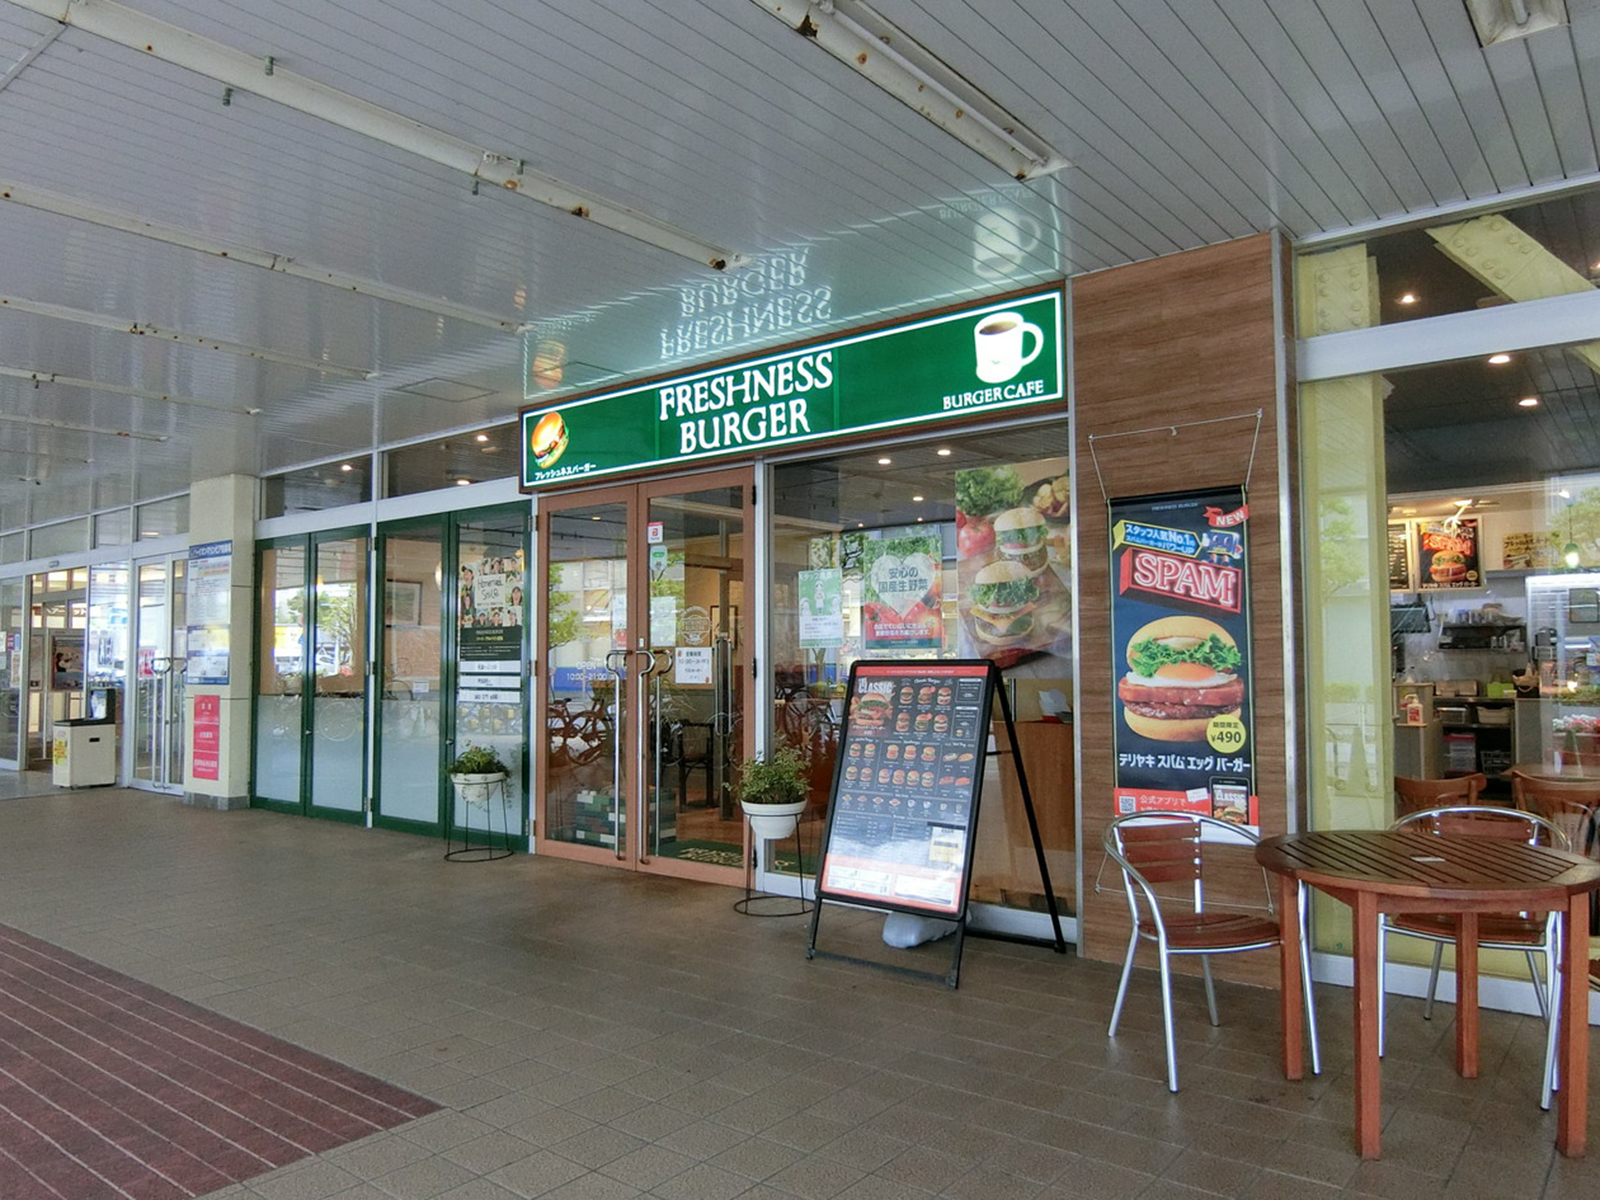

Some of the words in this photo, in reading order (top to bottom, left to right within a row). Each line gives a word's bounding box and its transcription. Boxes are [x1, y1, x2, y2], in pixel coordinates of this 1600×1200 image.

[659, 351, 834, 422] FRESHNESS
[942, 386, 1003, 410] BURGER
[1003, 379, 1045, 400] CAFE
[680, 398, 811, 454] BURGER
[1216, 510, 1246, 526] NEW
[889, 567, 919, 579] 安心の
[1134, 552, 1236, 606] SPAM
[878, 578, 928, 593] 国産生野菜
[1210, 731, 1242, 744] ¥490
[1119, 753, 1155, 768] テリヤキ
[1157, 754, 1185, 769] スパム
[1187, 756, 1214, 771] エッグ
[1216, 757, 1251, 773] バーガー
